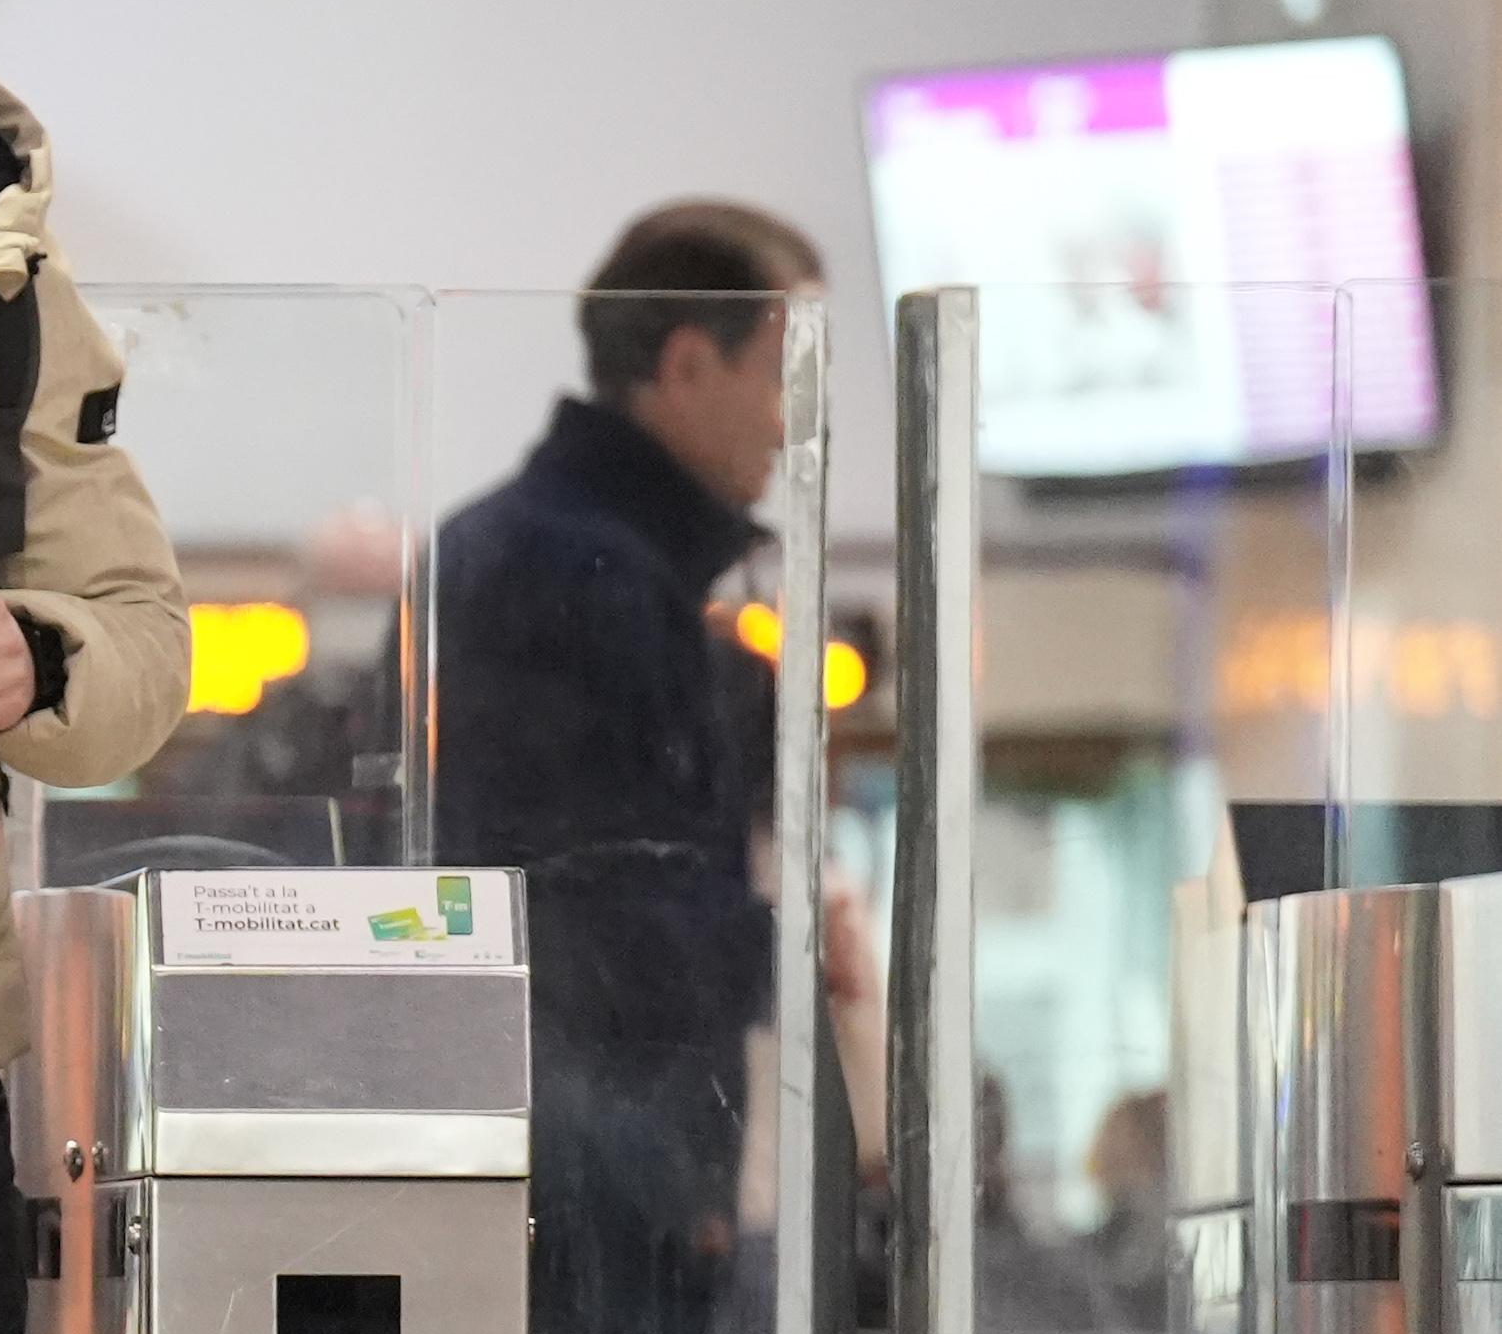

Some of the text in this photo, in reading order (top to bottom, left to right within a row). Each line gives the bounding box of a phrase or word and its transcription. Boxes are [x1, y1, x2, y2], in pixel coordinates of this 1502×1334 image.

[193, 885, 298, 898] Passa't a la
[194, 901, 316, 915] T-mobilitat a
[195, 917, 341, 932] T-mobilitat.cat
